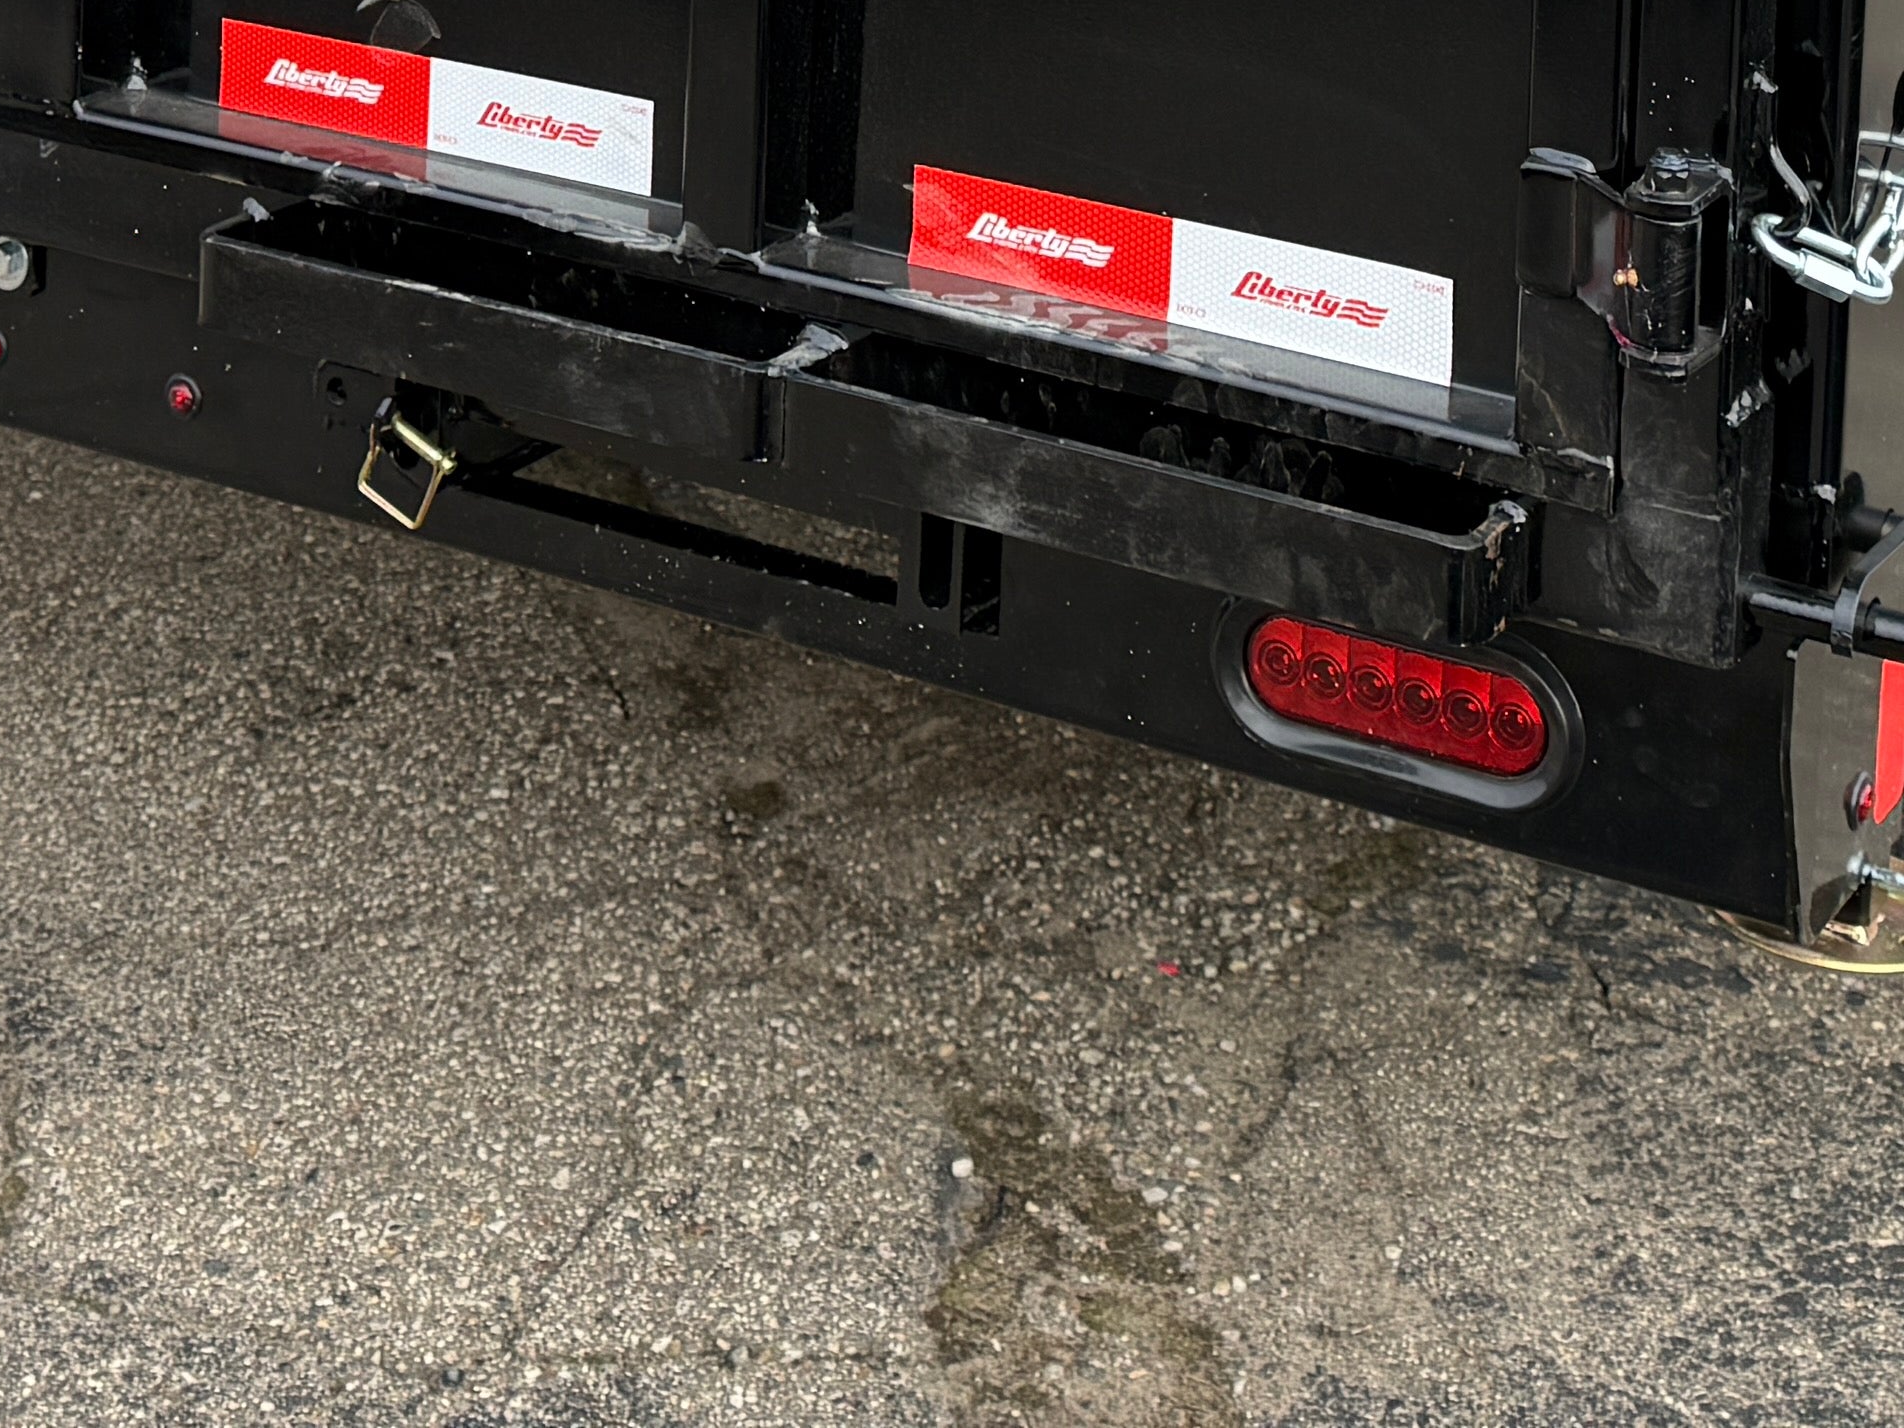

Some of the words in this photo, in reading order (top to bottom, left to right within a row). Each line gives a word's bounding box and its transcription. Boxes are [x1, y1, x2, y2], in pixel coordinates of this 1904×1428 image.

[263, 57, 348, 97] Liberty
[476, 100, 564, 142] Liberty
[965, 211, 1072, 259] Liberty
[1230, 270, 1343, 319] Liberty
